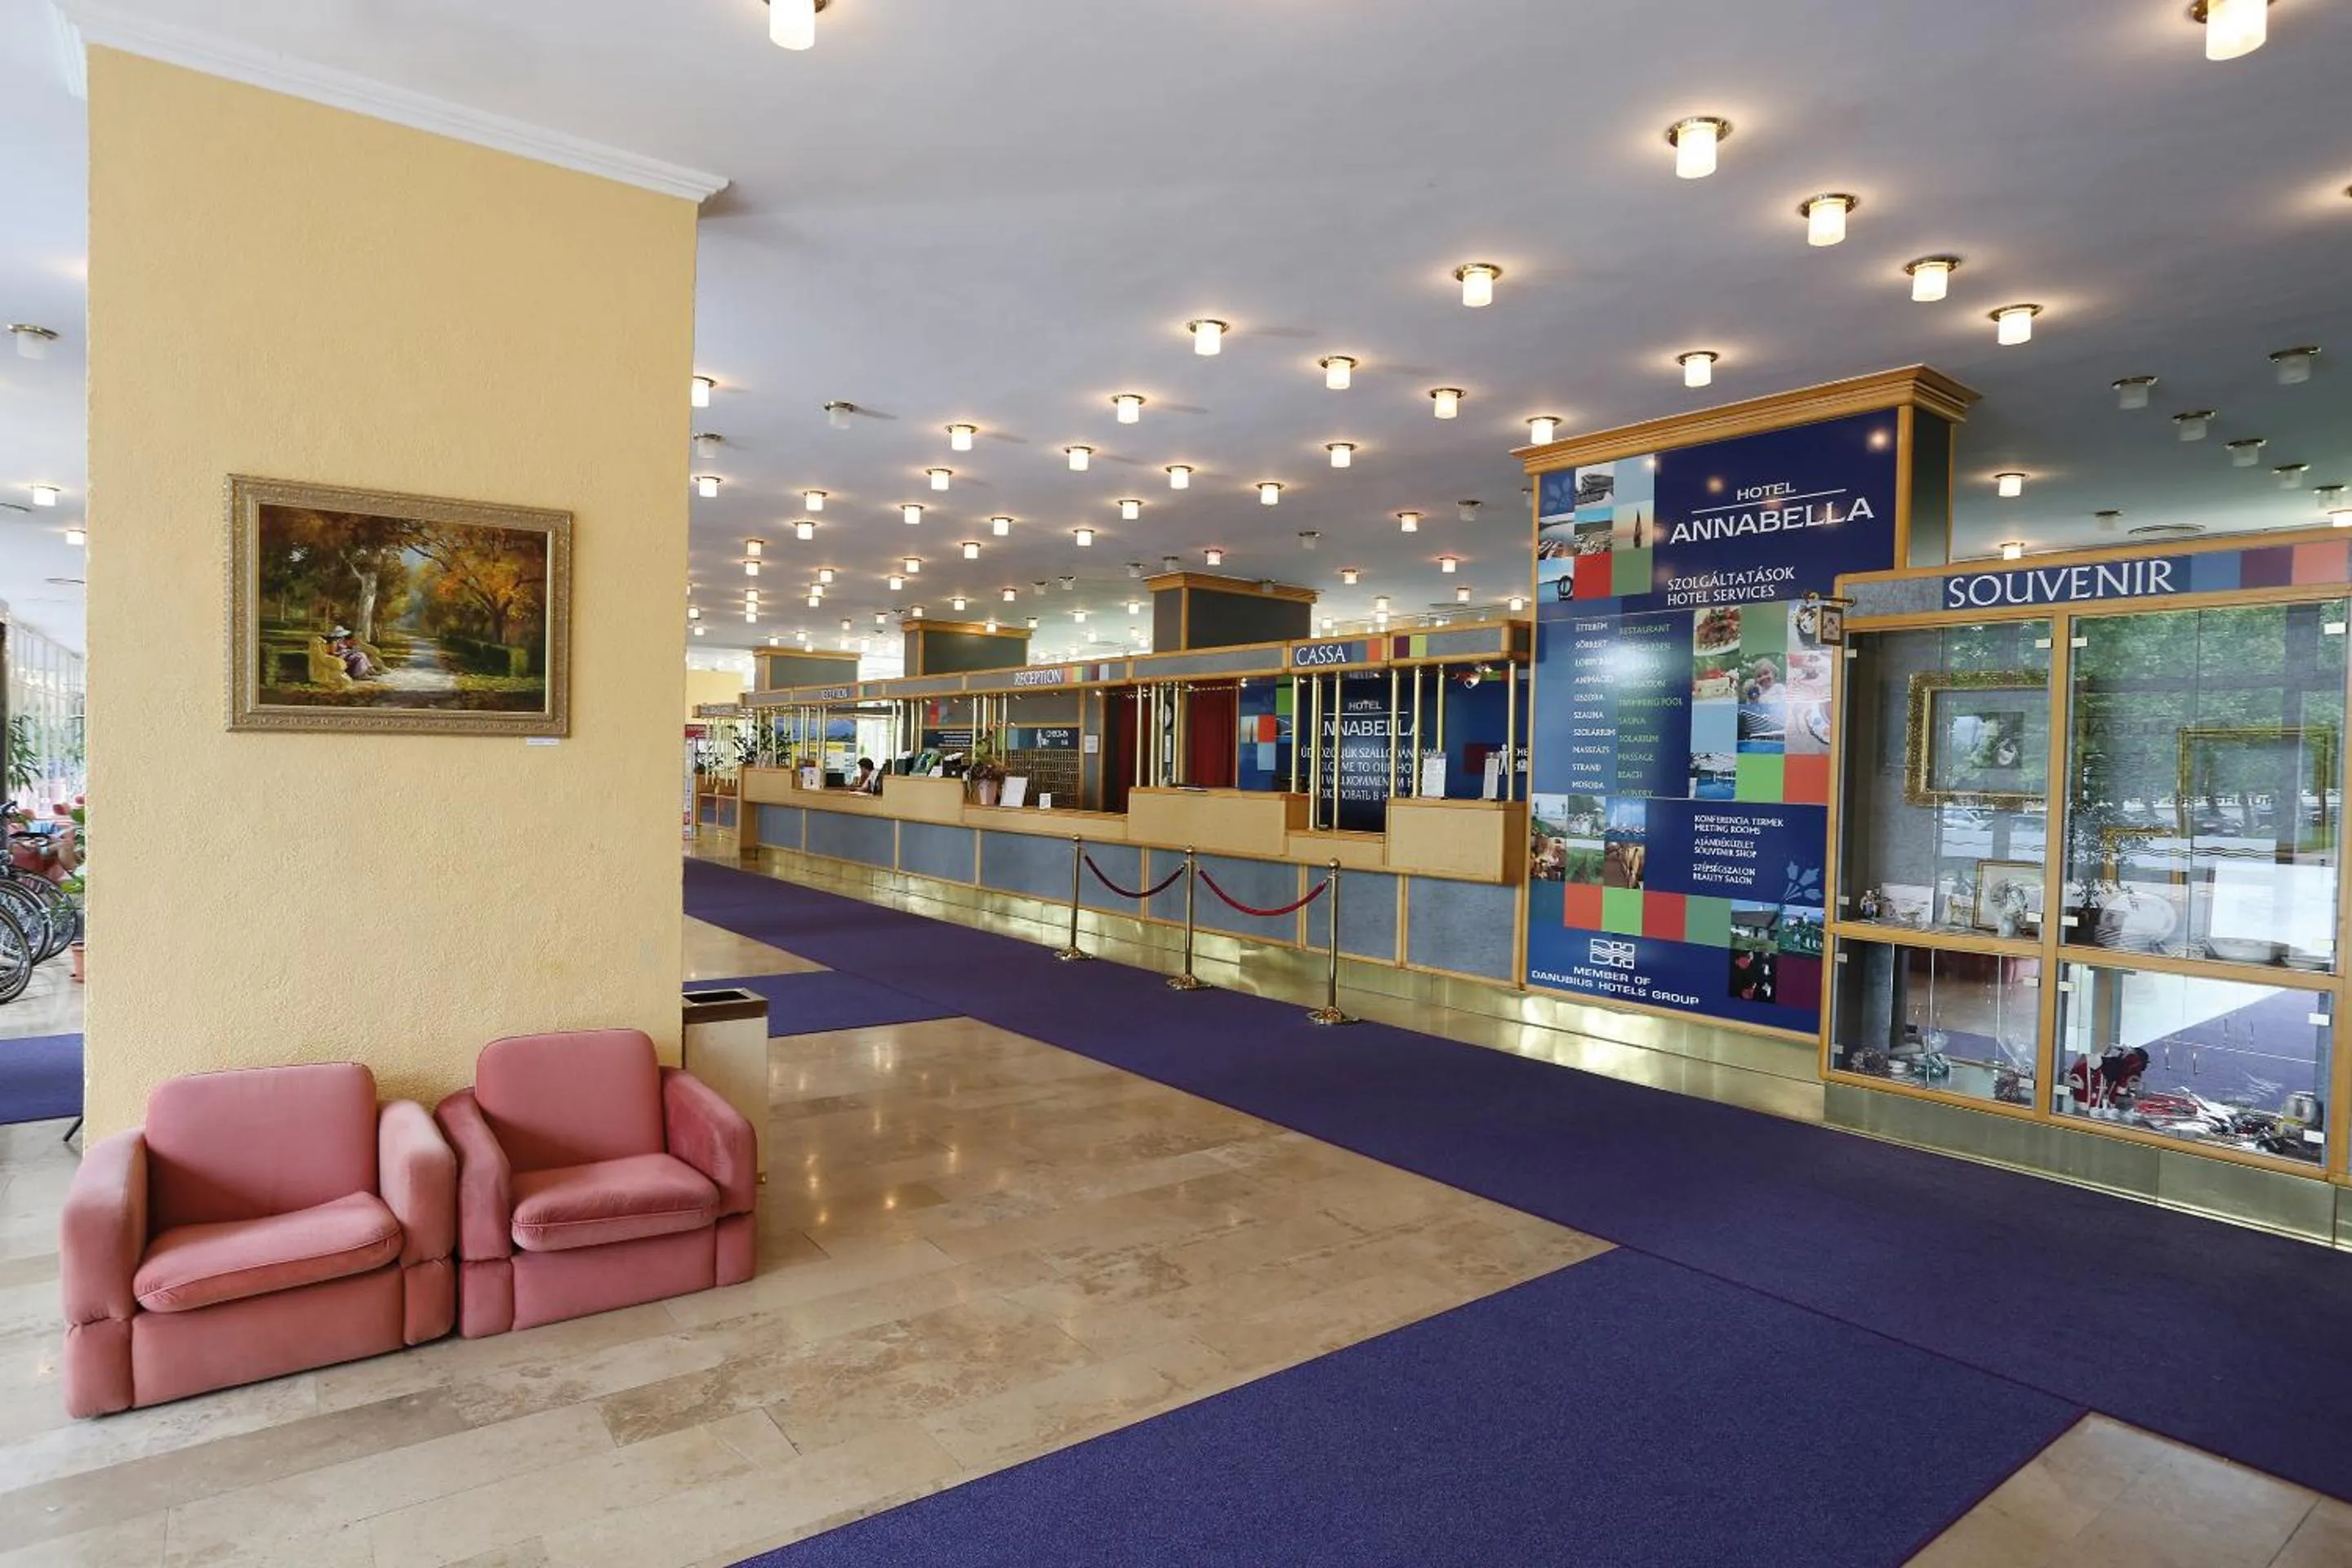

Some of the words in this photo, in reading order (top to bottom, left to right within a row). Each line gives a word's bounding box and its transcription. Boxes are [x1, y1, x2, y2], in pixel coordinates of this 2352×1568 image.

[1736, 482, 1797, 501] HOTEL
[1669, 497, 1875, 545] ANNABELLA
[1667, 565, 1795, 591] SZOLGÁLTATÁSOK
[1947, 558, 2176, 609] SOUVENIR
[1667, 591, 1710, 607] HOTEL
[1713, 584, 1775, 603] SERVICES
[1619, 623, 1672, 635] RESTAURANT
[1296, 644, 1346, 666] CASSA
[1013, 669, 1062, 686] RECEPTION
[1348, 700, 1382, 710] HOTEL
[1618, 716, 1646, 726] SAUNA
[1619, 734, 1659, 743] SOLARIUM
[1617, 753, 1654, 762] MASSAGE
[1357, 761, 1371, 773] TO
[1572, 763, 1601, 773] STRAND
[1618, 770, 1643, 779] BEACH
[1752, 817, 1784, 827] TERMEK
[1694, 823, 1729, 834] MEETING
[1731, 825, 1761, 835] ROOMS
[1694, 846, 1734, 858] SOUVENIR
[1735, 849, 1757, 858] SHOP
[1692, 872, 1723, 883] BEAUTY
[1724, 874, 1753, 885] SALON
[1573, 965, 1629, 983] MEMBER
[1634, 975, 1652, 986] OF
[1531, 969, 1593, 988] DANUBIUS
[1598, 981, 1647, 998] HOTELS
[1651, 989, 1699, 1005] GROUP
